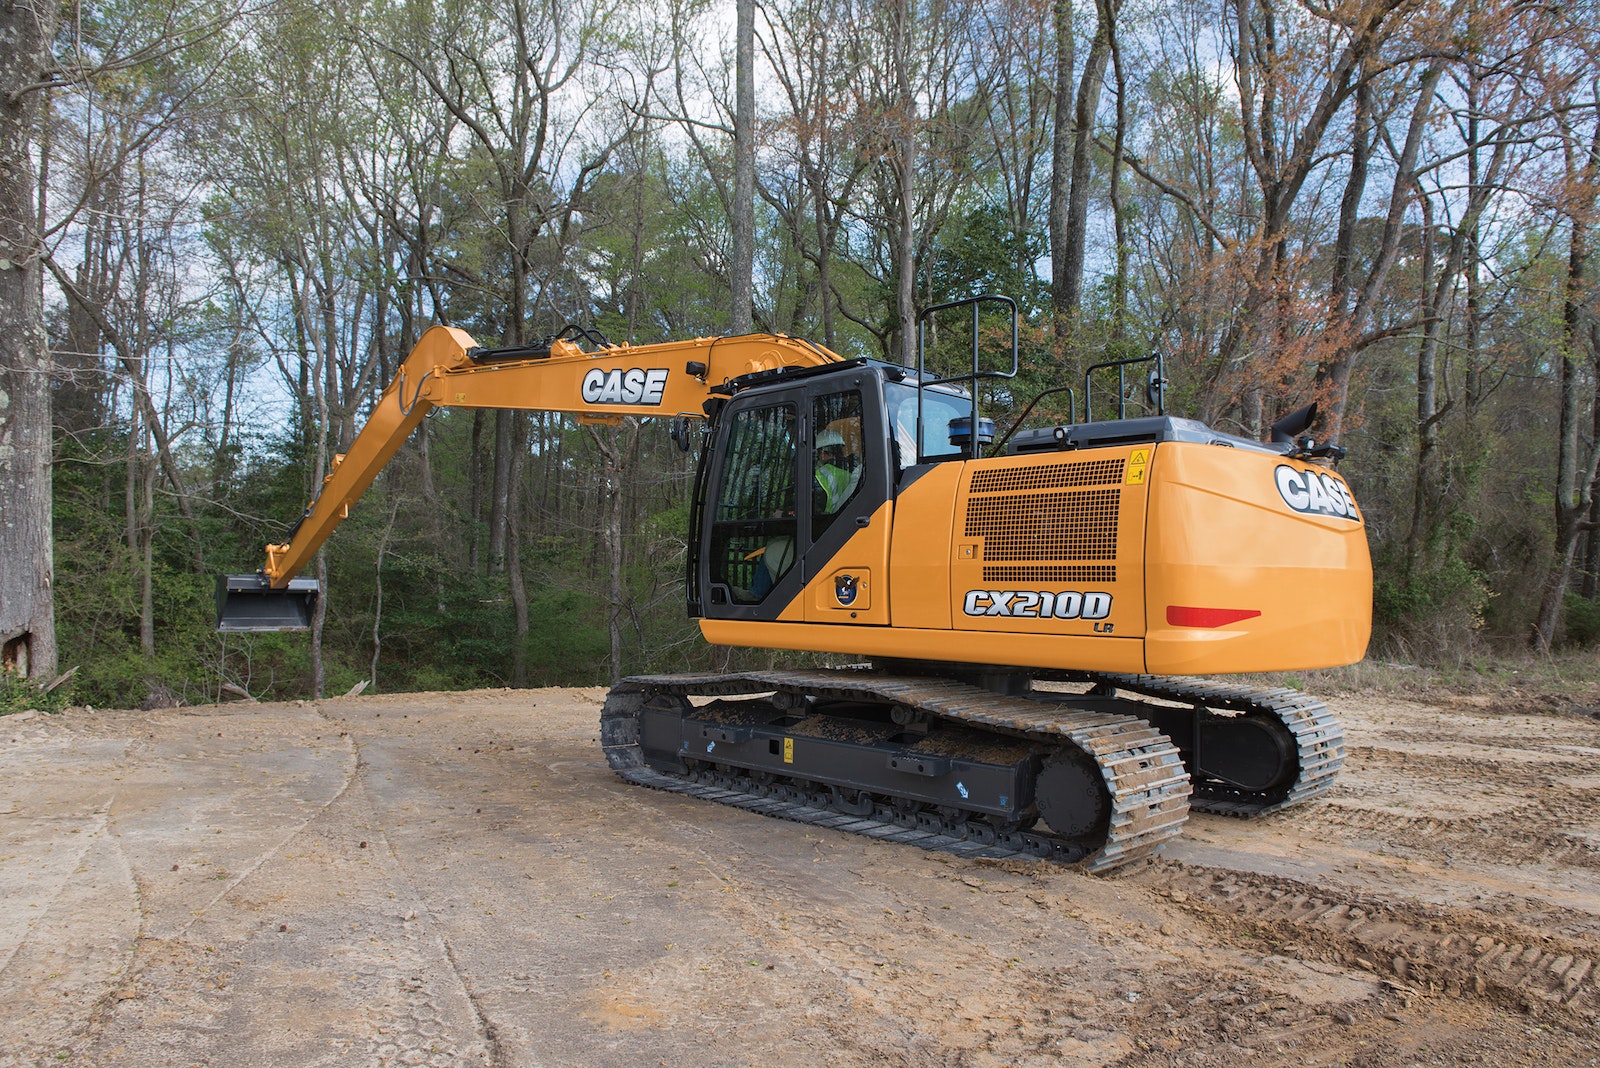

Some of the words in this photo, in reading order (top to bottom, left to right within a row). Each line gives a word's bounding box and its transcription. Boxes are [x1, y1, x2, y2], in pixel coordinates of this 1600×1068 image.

[582, 368, 669, 405] CASE
[1275, 465, 1359, 520] CASE
[963, 590, 1113, 619] CX210D
